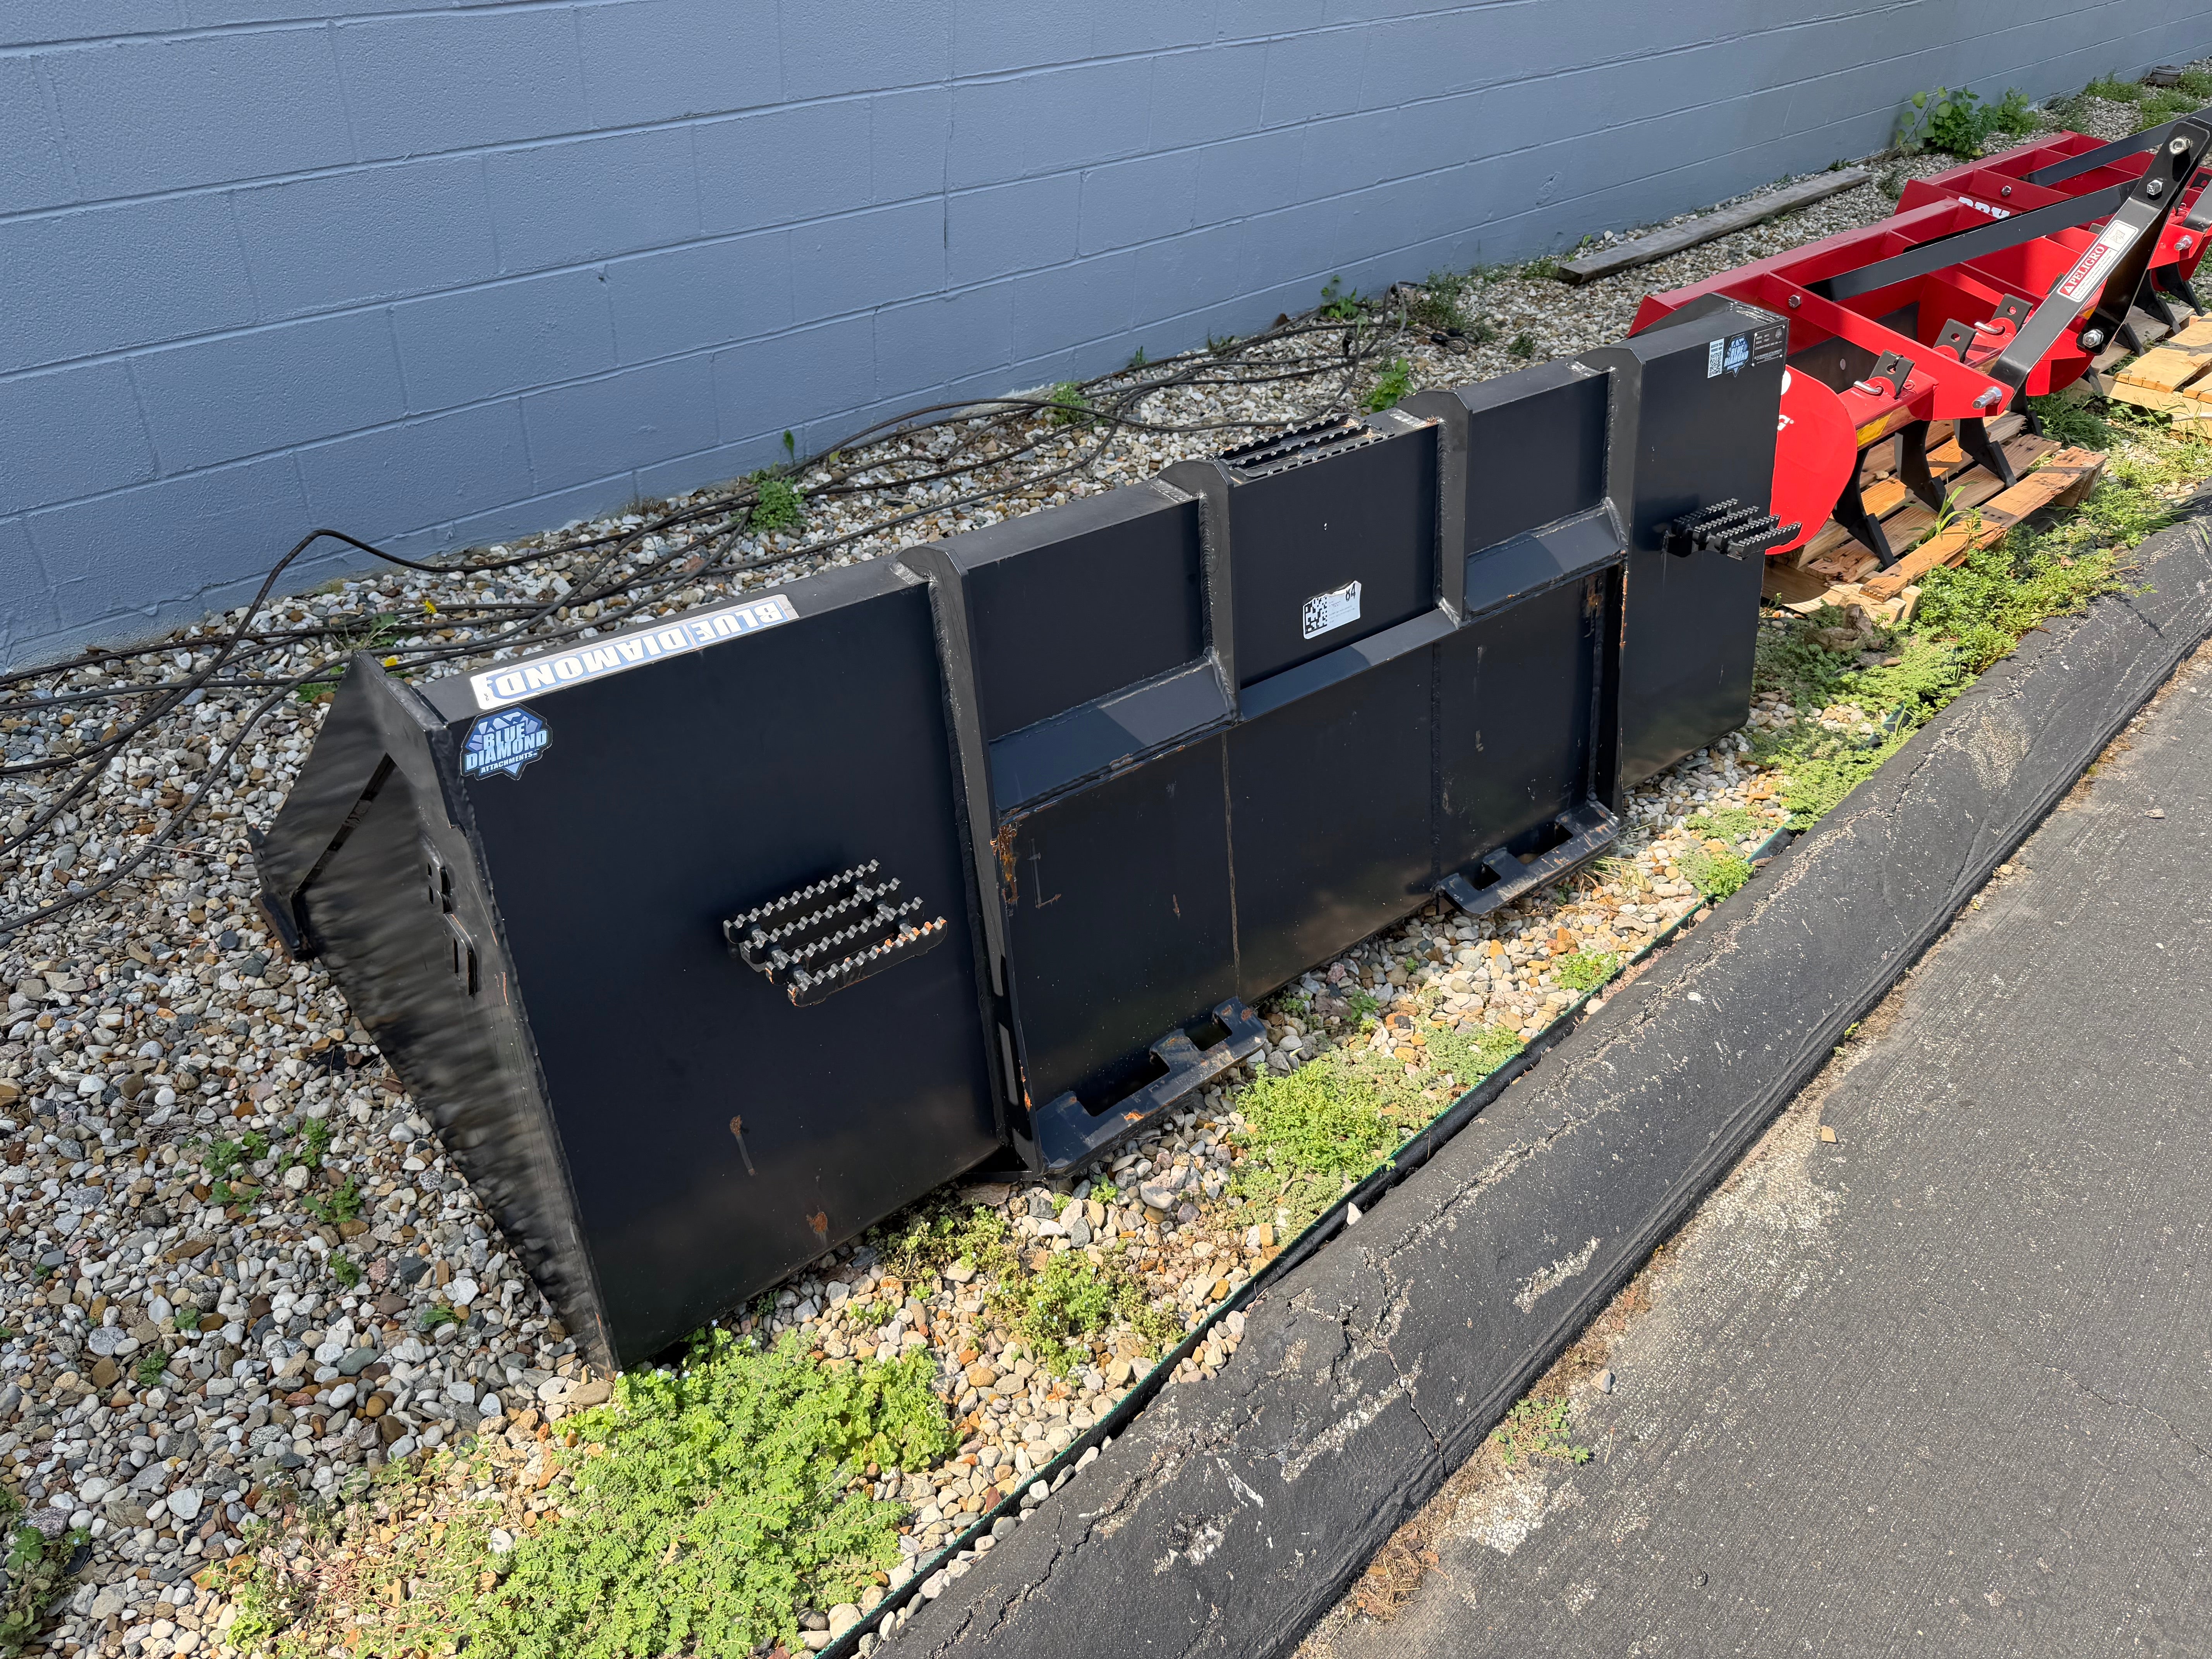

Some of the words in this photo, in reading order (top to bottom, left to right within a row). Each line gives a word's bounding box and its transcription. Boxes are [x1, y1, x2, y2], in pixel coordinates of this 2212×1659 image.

[2070, 246, 2105, 285] PELIGRO
[698, 602, 784, 641] BLUE
[495, 628, 689, 696] DIAMOND
[466, 730, 547, 770] DIAMOND
[483, 722, 526, 750] BLUE
[481, 751, 534, 774] ATTACHMENTS
